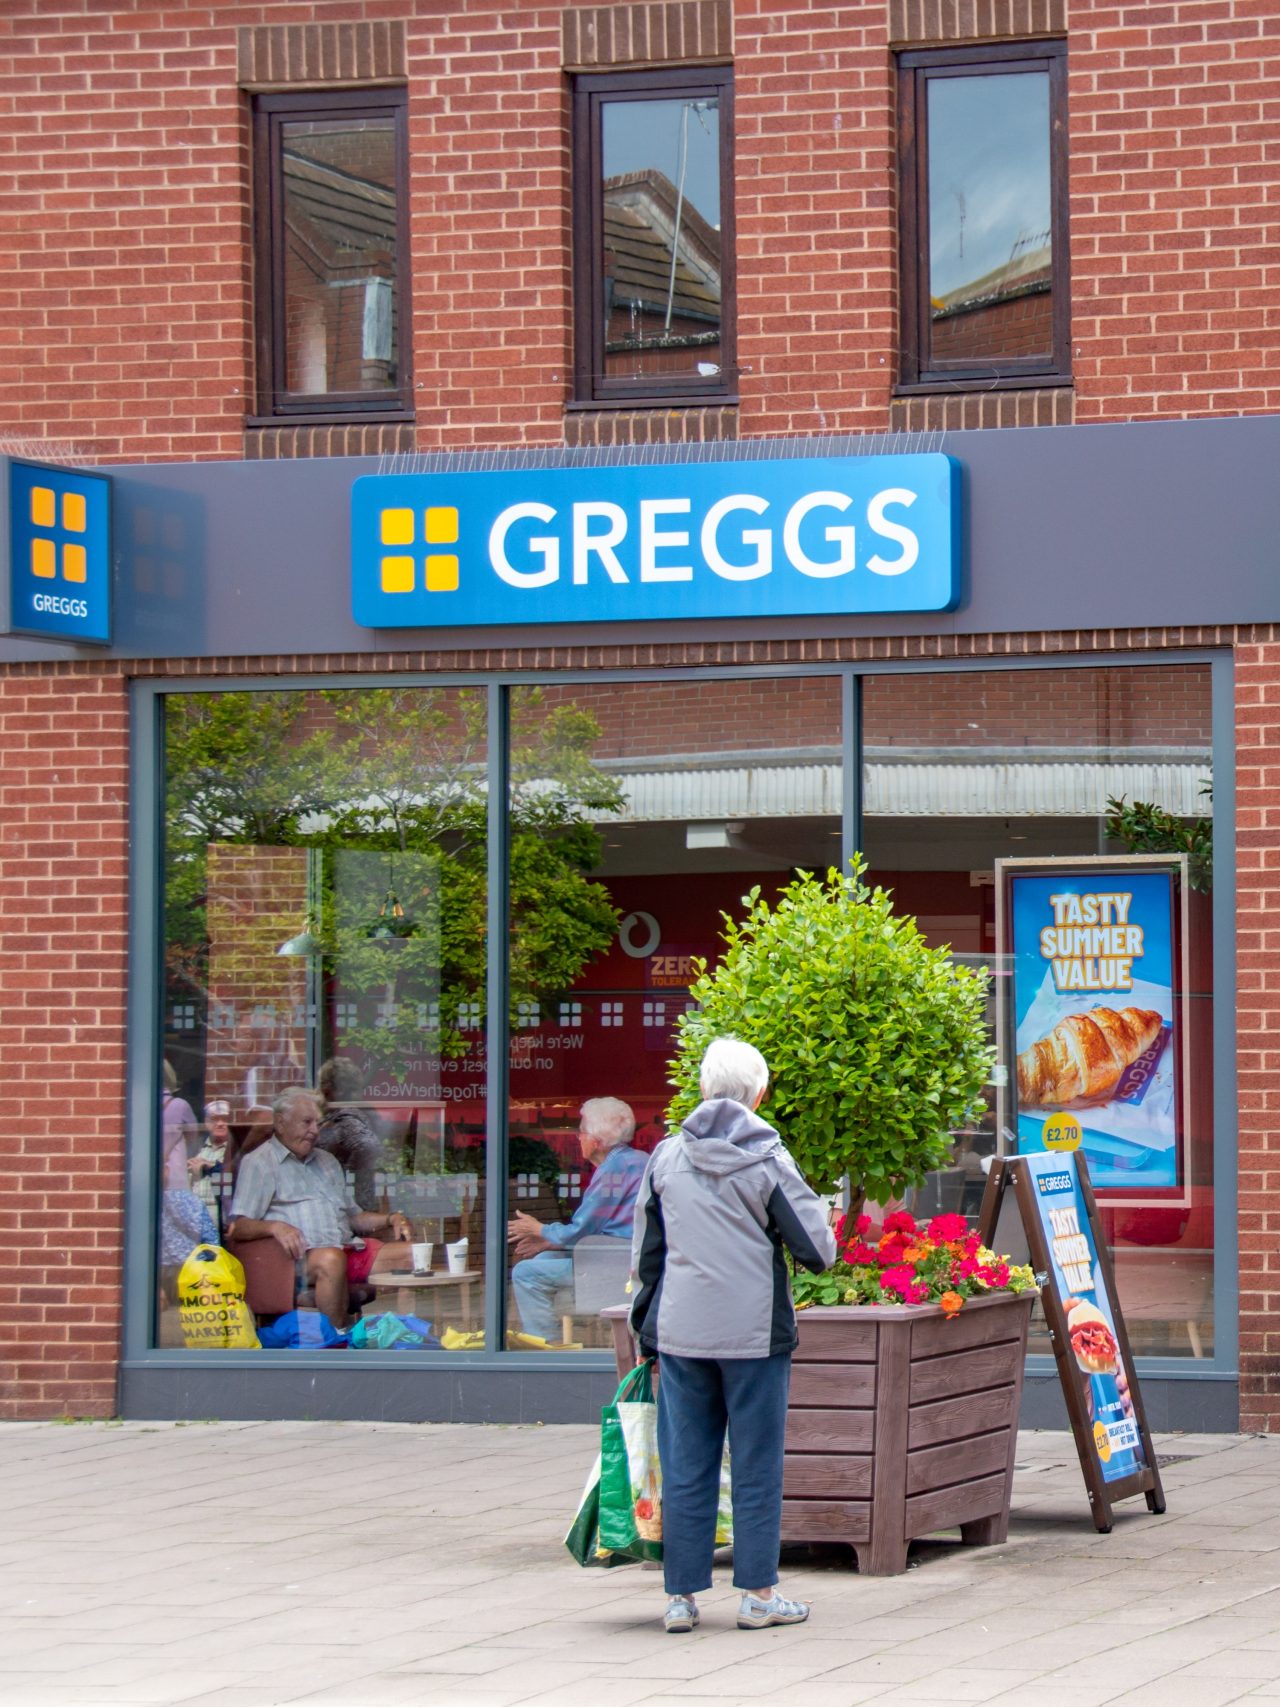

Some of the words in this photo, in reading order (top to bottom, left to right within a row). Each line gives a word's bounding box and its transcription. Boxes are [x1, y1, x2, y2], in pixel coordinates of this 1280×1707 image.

[488, 488, 919, 588] GREGGS
[33, 593, 88, 618] GREGGS
[1052, 894, 1132, 924] TASTY
[1041, 926, 1143, 955] SUMMER
[650, 956, 692, 976] ZER
[1054, 959, 1132, 988] VALUE
[1046, 1127, 1079, 1141] £2.70
[1045, 1175, 1072, 1191] GREGGS
[1048, 1206, 1081, 1236] TASTY
[1061, 1262, 1095, 1293] VALUE
[181, 1292, 243, 1308] MOUTH
[180, 1309, 240, 1325] INDOOR
[184, 1325, 242, 1339] MARKET
